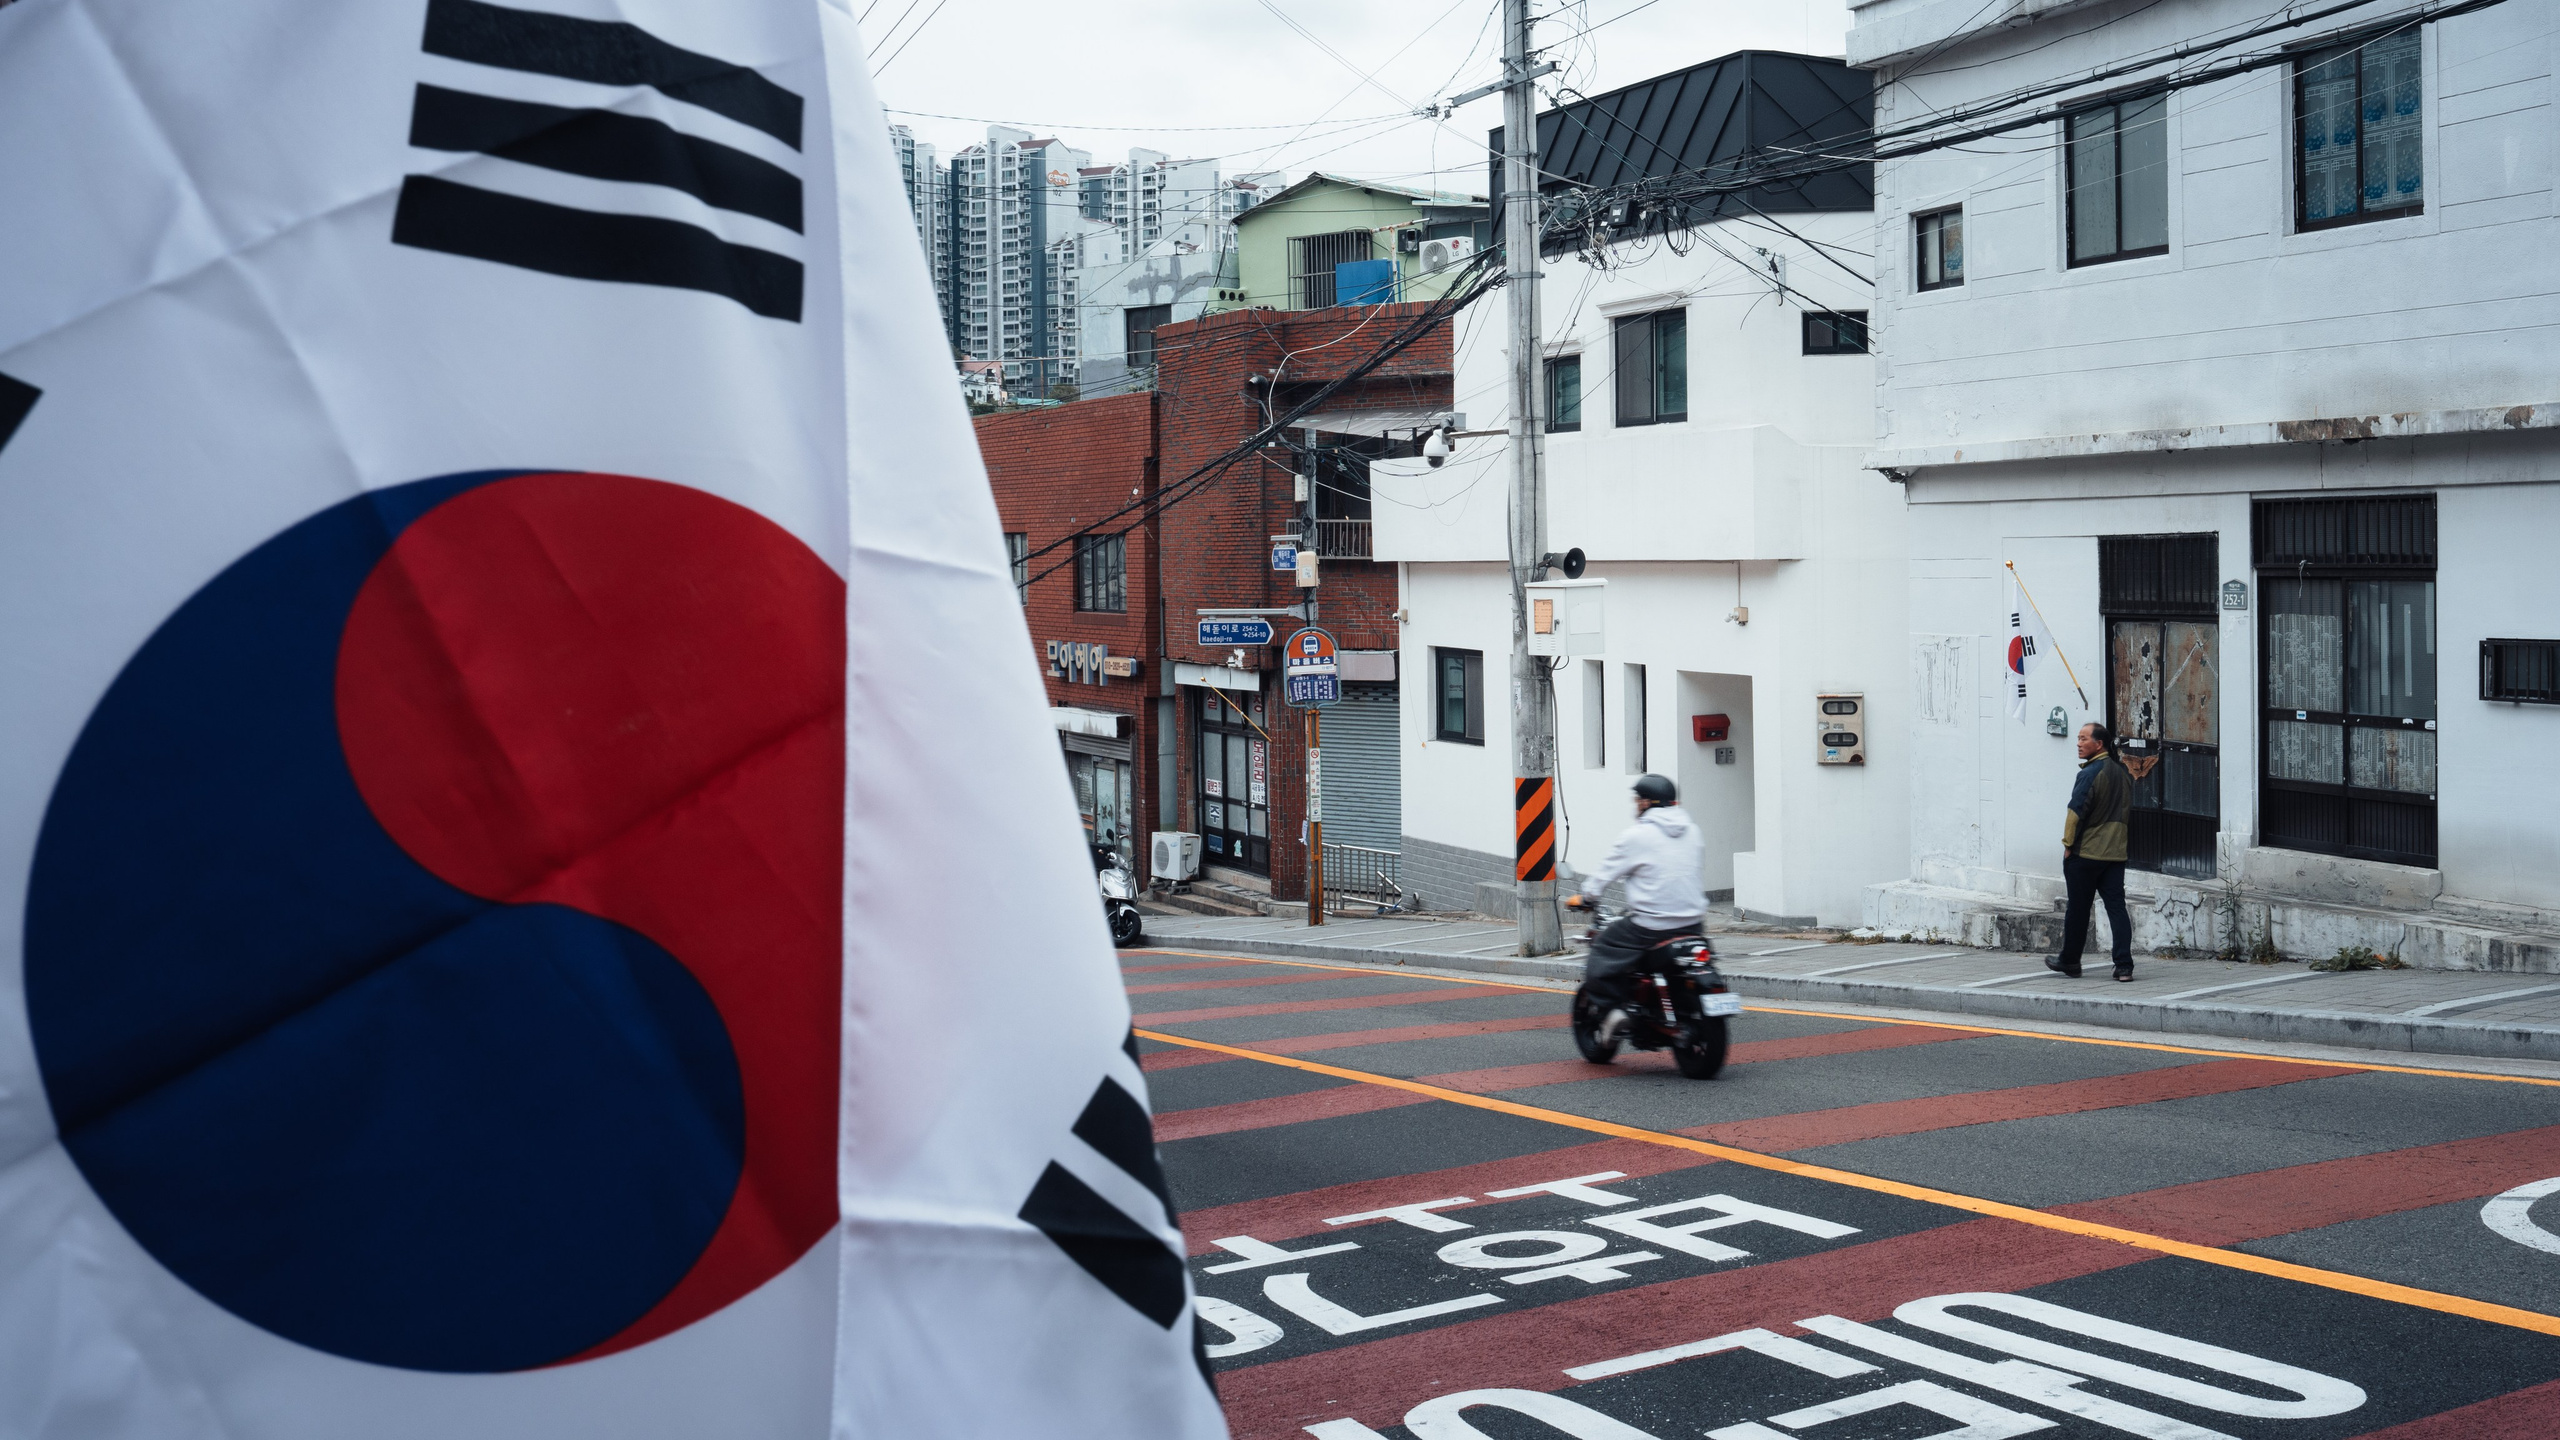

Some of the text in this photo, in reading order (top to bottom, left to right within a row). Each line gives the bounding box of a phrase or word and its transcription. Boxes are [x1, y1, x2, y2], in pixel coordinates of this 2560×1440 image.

[1053, 189, 1061, 197] 102
[2224, 594, 2244, 606] 252-1
[1202, 624, 1239, 634] 해돋이로
[1046, 640, 1106, 686] 모아헤어
[1292, 656, 1331, 666] 마을버스
[1253, 741, 1265, 783] 보일러
[1210, 804, 1220, 823] 주
